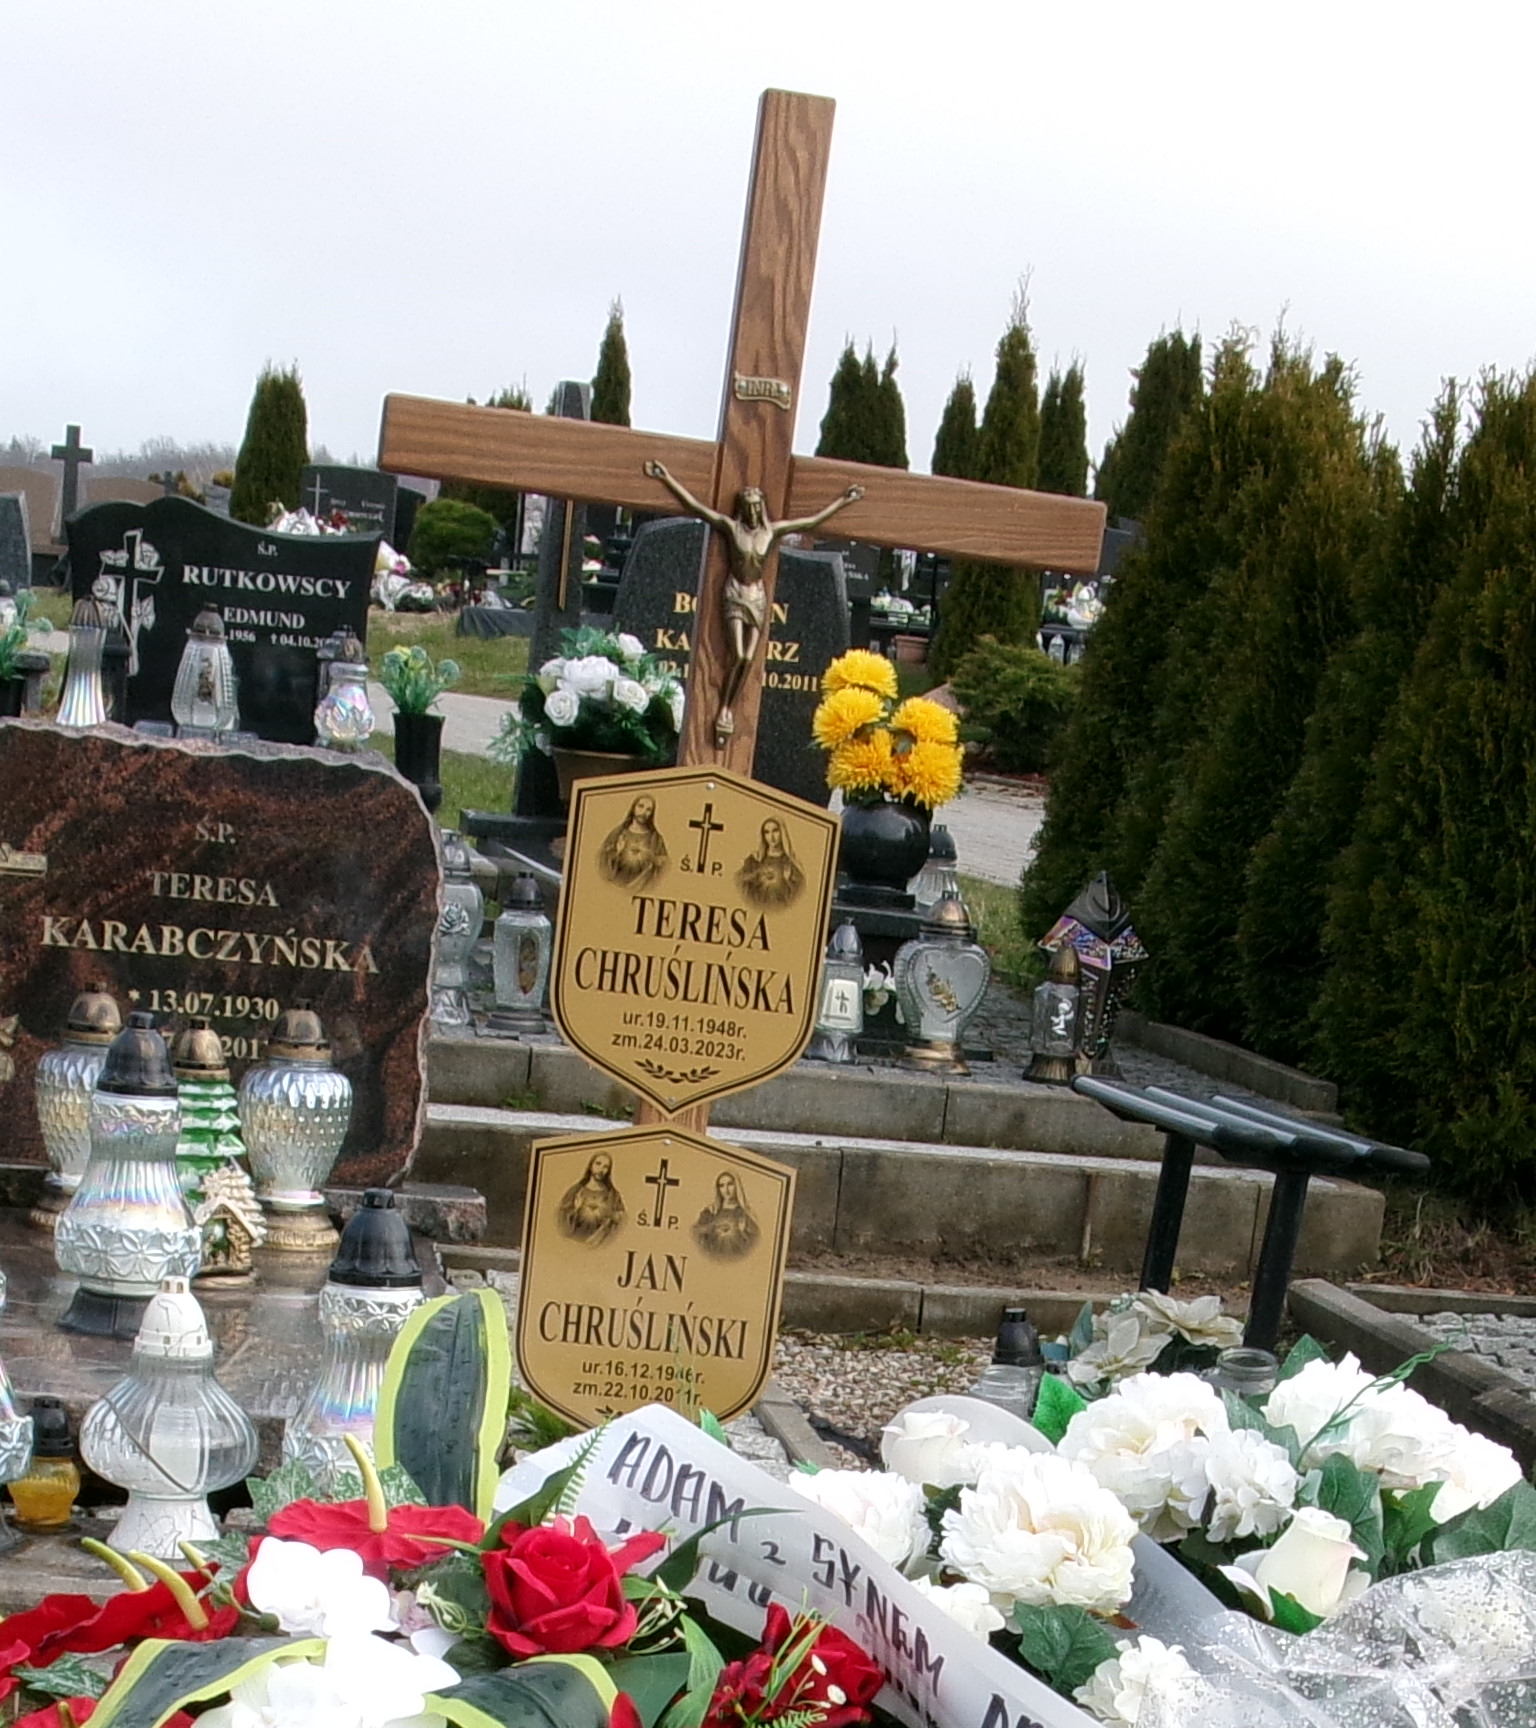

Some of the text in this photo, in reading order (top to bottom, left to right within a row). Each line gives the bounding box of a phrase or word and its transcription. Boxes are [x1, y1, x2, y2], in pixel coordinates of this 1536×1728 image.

[182, 564, 352, 599] RUTKOWSCY
[223, 606, 306, 630] EDMUND
[150, 871, 280, 908] TERESA
[632, 895, 772, 952] TERESA
[40, 914, 380, 975] KARABCZYŃSKA
[574, 943, 796, 1017] CHRUŚLIŃSKA
[149, 988, 280, 1021] 13.07.1930
[622, 1009, 749, 1041] ur.19.11.1948r.
[611, 1031, 748, 1063] zm.24.03.2023r.
[617, 1250, 689, 1295] JAN
[538, 1296, 750, 1362] CHRUŚLIŃSKI
[606, 1430, 747, 1544] ADAM
